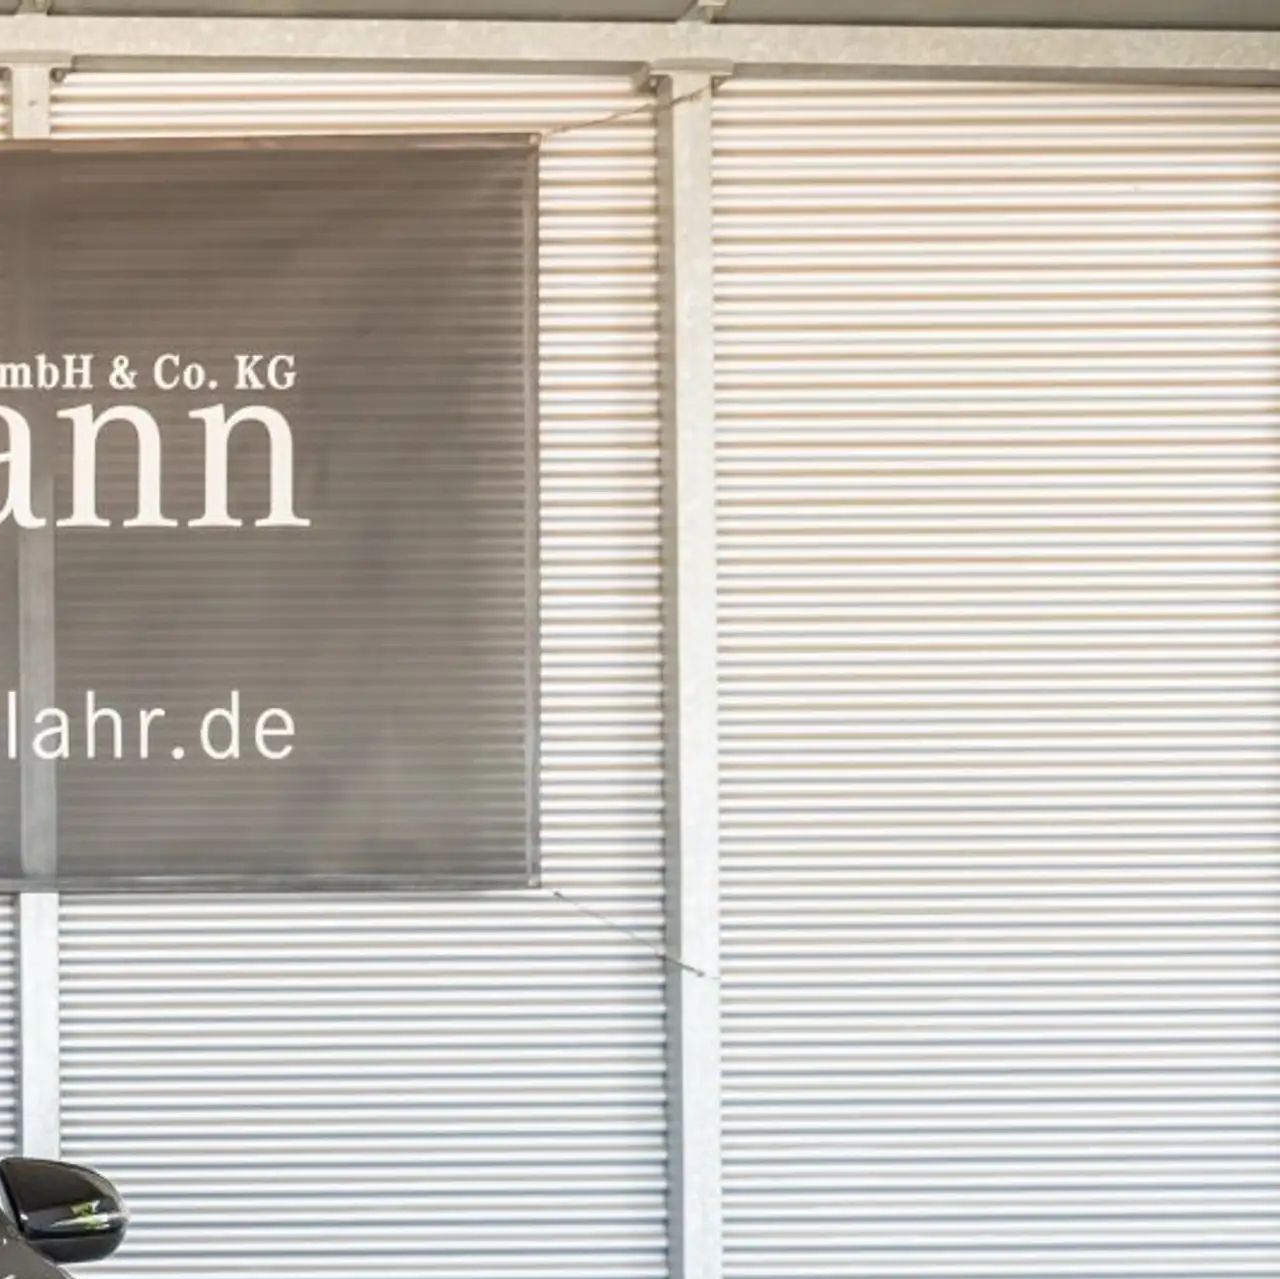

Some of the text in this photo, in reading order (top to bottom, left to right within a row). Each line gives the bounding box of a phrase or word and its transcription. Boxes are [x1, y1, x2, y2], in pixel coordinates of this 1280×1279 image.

[108, 355, 137, 390] &
[154, 353, 218, 390] Co.
[235, 354, 296, 390] KG
